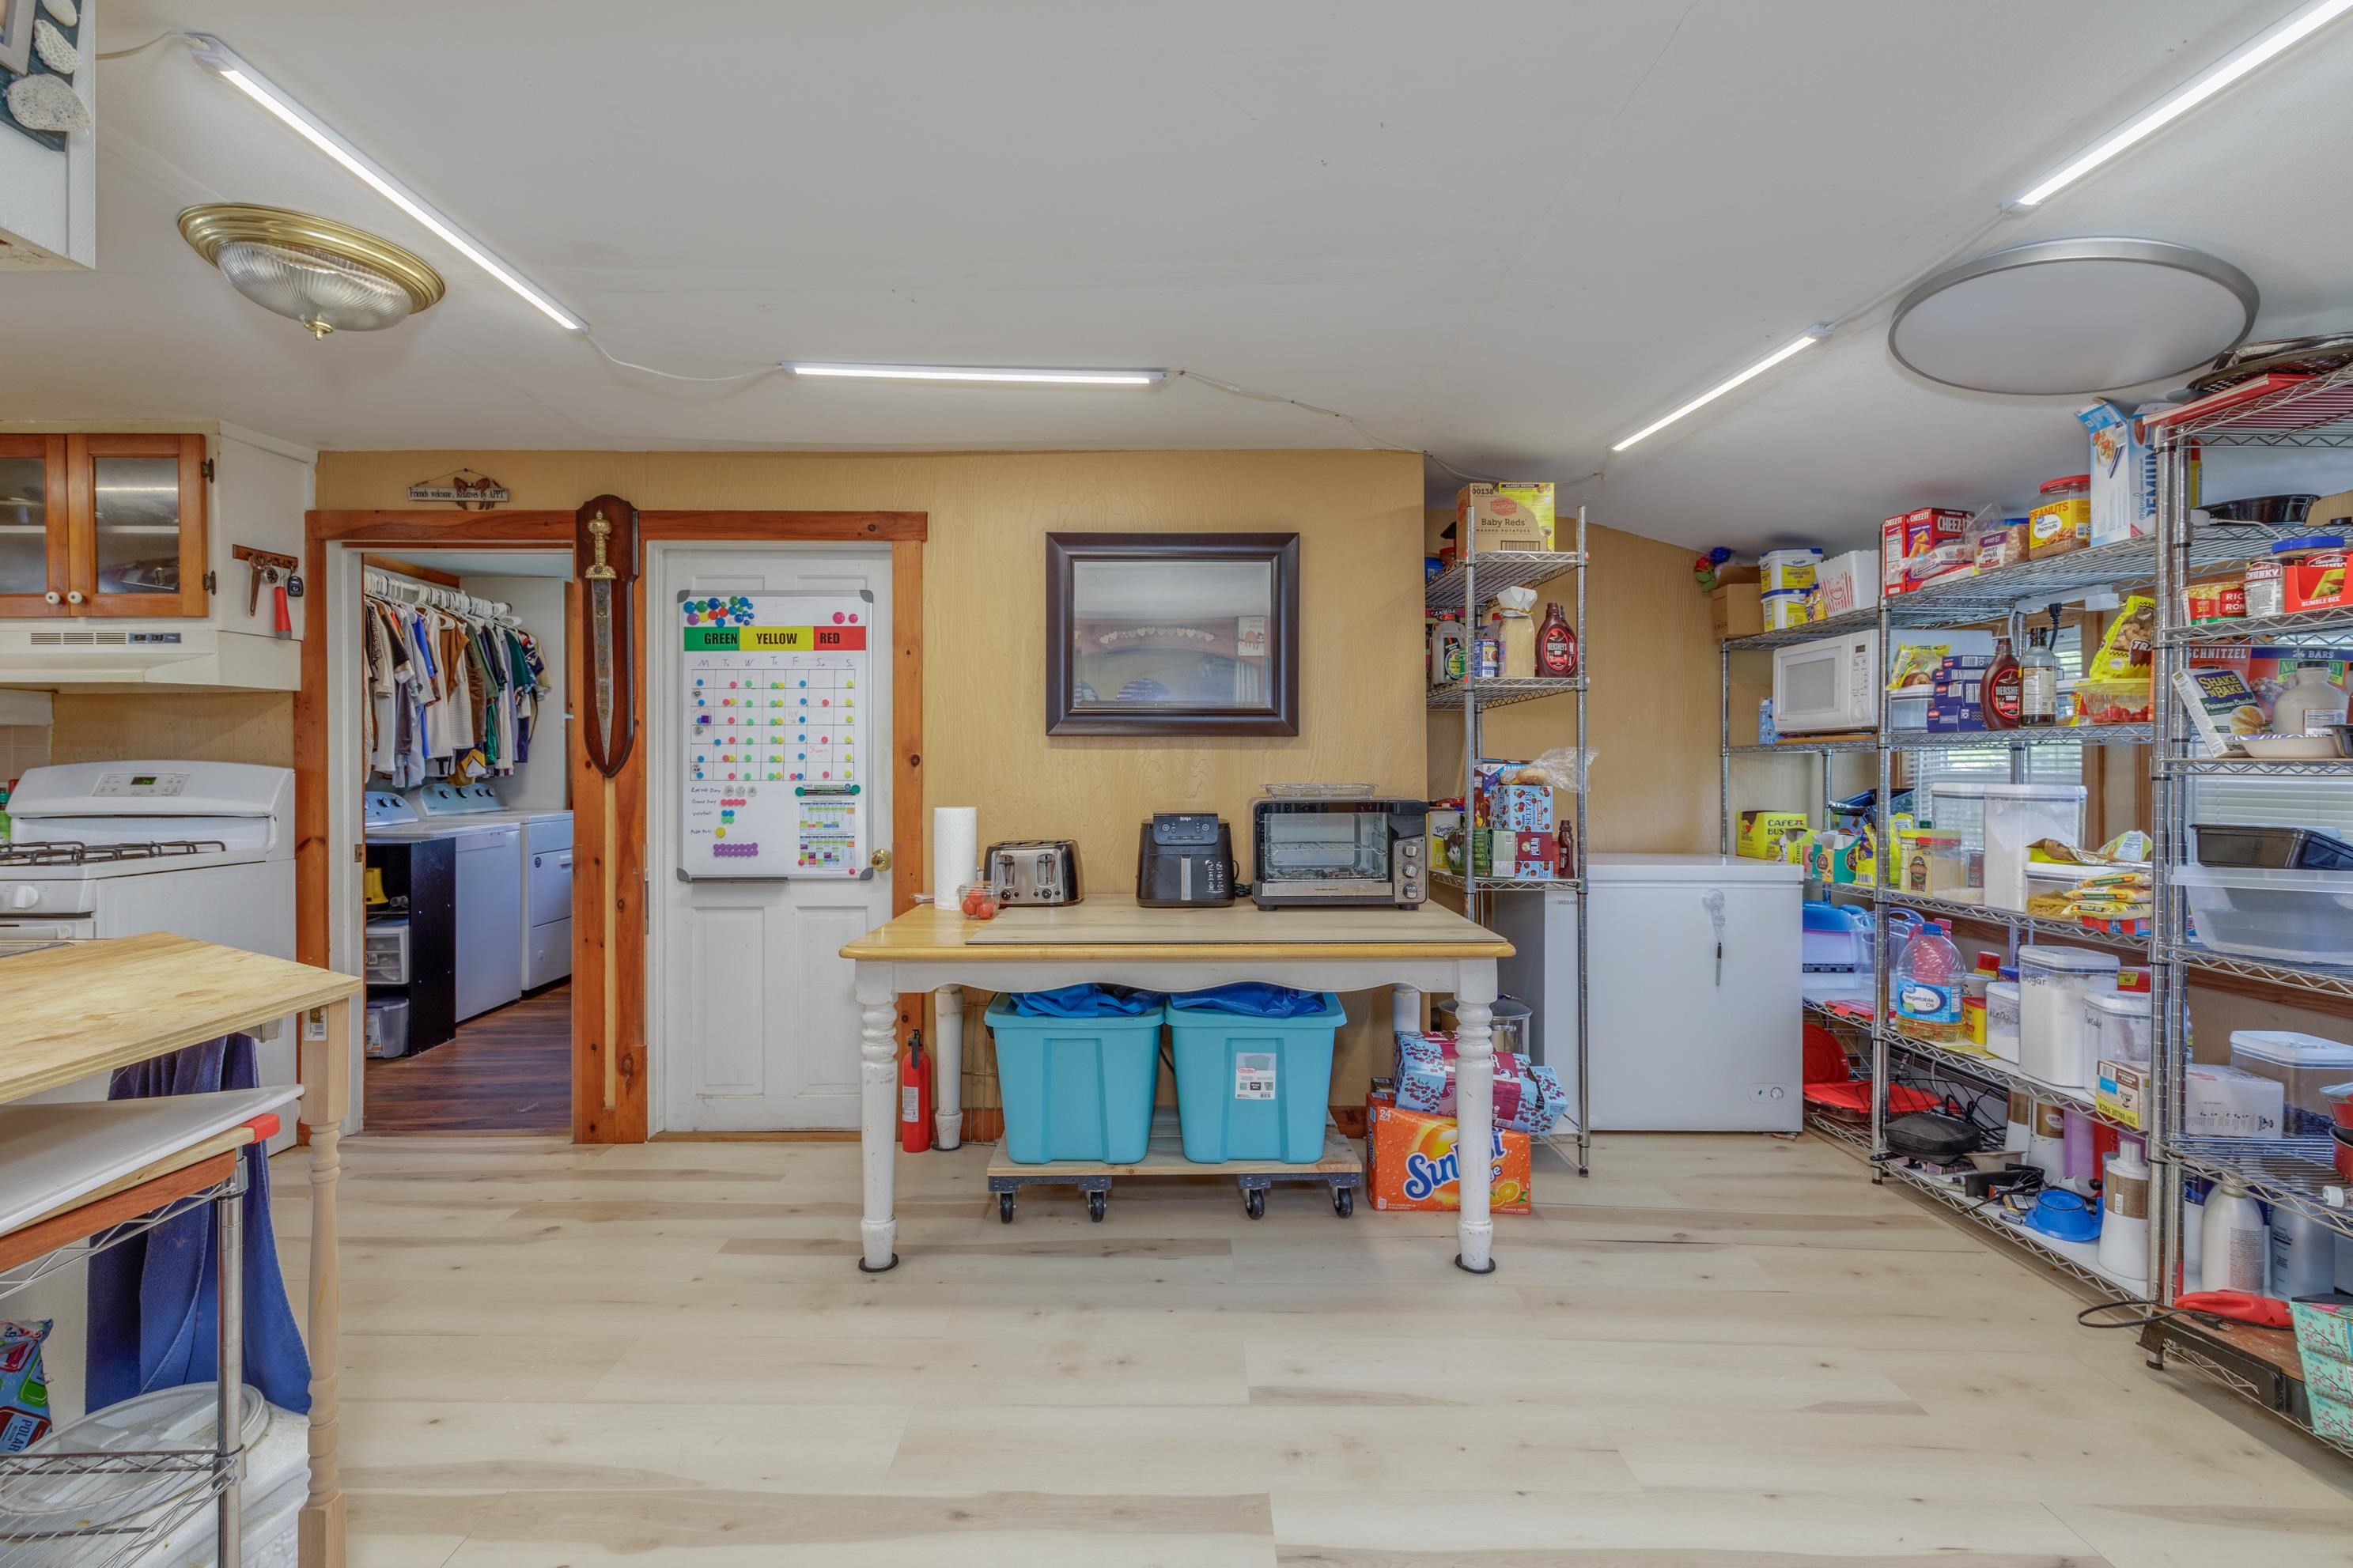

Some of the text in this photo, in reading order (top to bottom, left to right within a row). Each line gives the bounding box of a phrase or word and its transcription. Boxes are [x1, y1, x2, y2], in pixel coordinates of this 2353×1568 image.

[409, 487, 429, 497] Friends
[481, 490, 486, 500] by
[2030, 502, 2068, 519] PEANUTS
[2133, 493, 2145, 520] original
[1481, 518, 1503, 527] Baby
[2037, 523, 2058, 533] Peanuts
[2246, 569, 2279, 579] CHUNKY
[2302, 598, 2327, 606] BUMBLE
[705, 633, 738, 644] GREEN
[756, 633, 797, 644] YELLOW
[820, 633, 840, 644] RED
[2188, 647, 2247, 659] SCHNITZEL
[2308, 650, 2335, 659] BARS
[2198, 674, 2239, 689] SHAKE
[1996, 686, 2018, 695] HERSHE
[2214, 684, 2245, 698] BAKE
[2204, 701, 2234, 710] Parmesan
[1531, 838, 1540, 856] POLAR
[1905, 993, 1934, 1003] Vegetable
[1379, 1109, 1390, 1117] 24
[2099, 1103, 2110, 1114] PACK
[2111, 1109, 2125, 1120] VALUE
[1405, 1127, 1505, 1200] Sunt
[7, 1419, 33, 1453] POLAR
